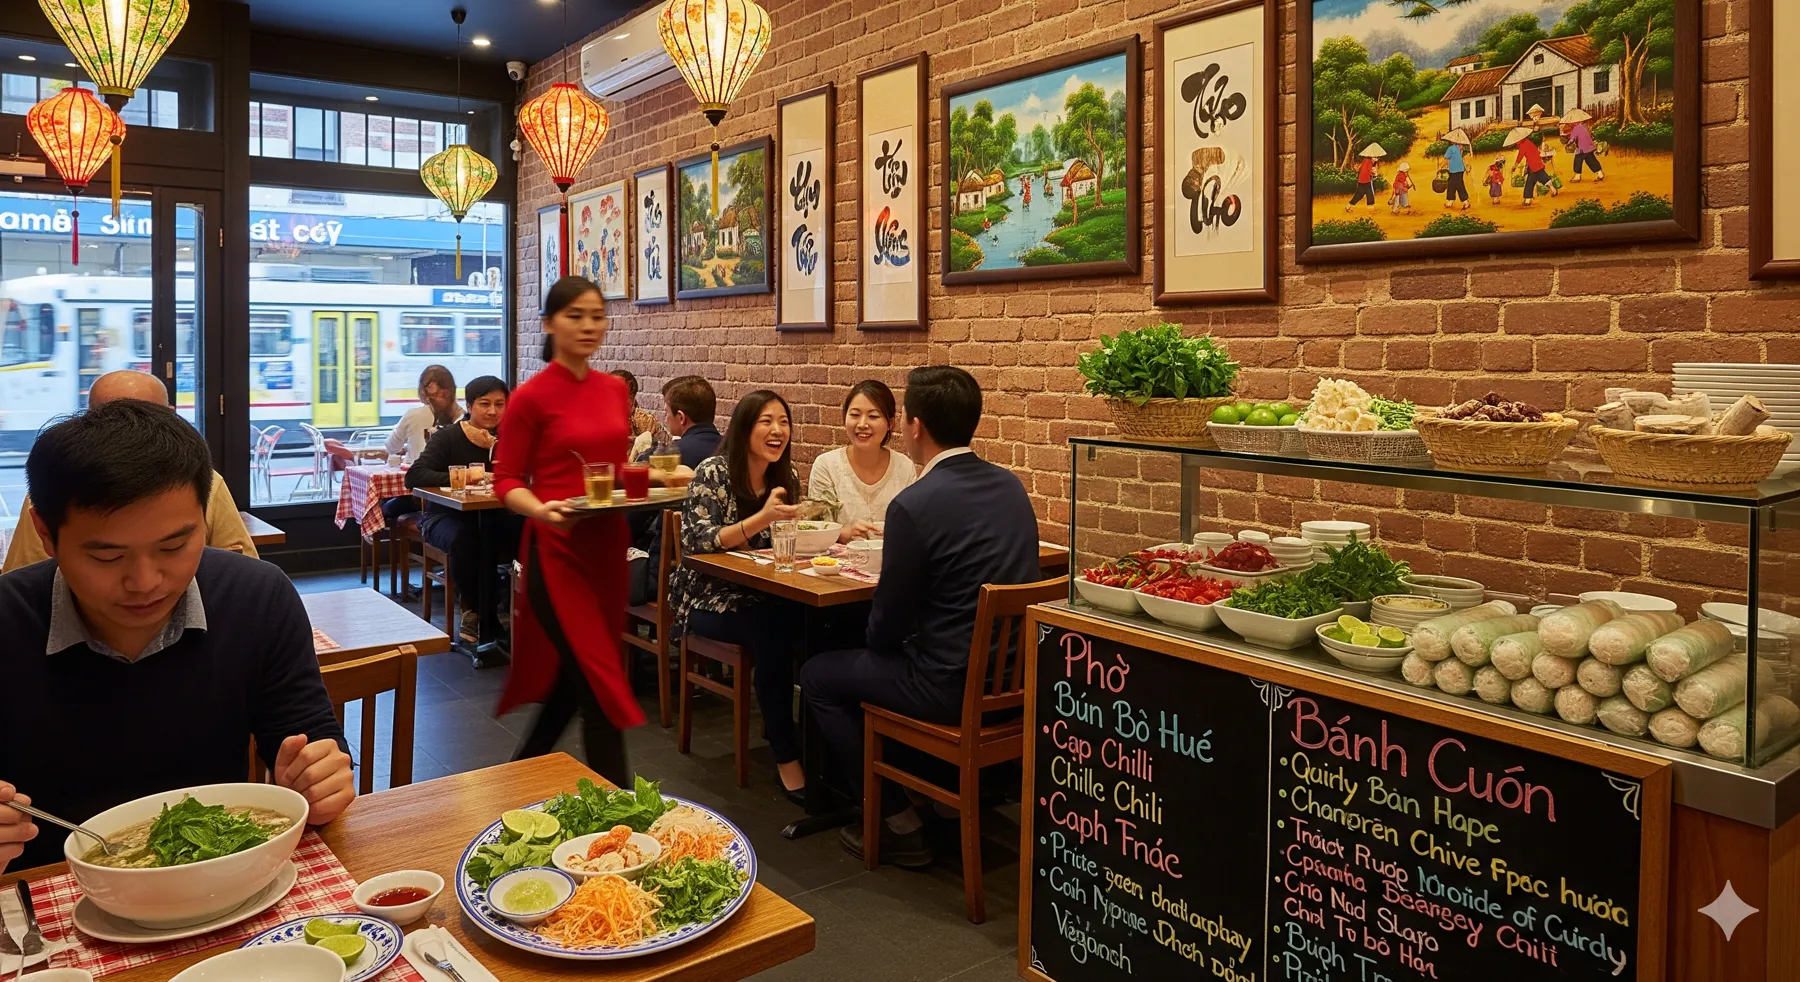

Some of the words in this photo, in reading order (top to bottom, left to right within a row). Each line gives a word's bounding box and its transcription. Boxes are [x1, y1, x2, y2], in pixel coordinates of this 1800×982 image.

[1053, 680, 1103, 729] Bún
[1112, 700, 1150, 742] Bò
[1158, 711, 1214, 763] Hué
[1101, 738, 1153, 782] Chilli
[1287, 697, 1407, 777] Bánh
[1428, 738, 1557, 823] Cuón
[1051, 755, 1105, 802] Chille
[1113, 781, 1163, 825] Chili
[1049, 791, 1108, 845] Caph
[1434, 796, 1501, 847] Hape
[1409, 829, 1482, 876] Chive
[1512, 905, 1538, 931] of
